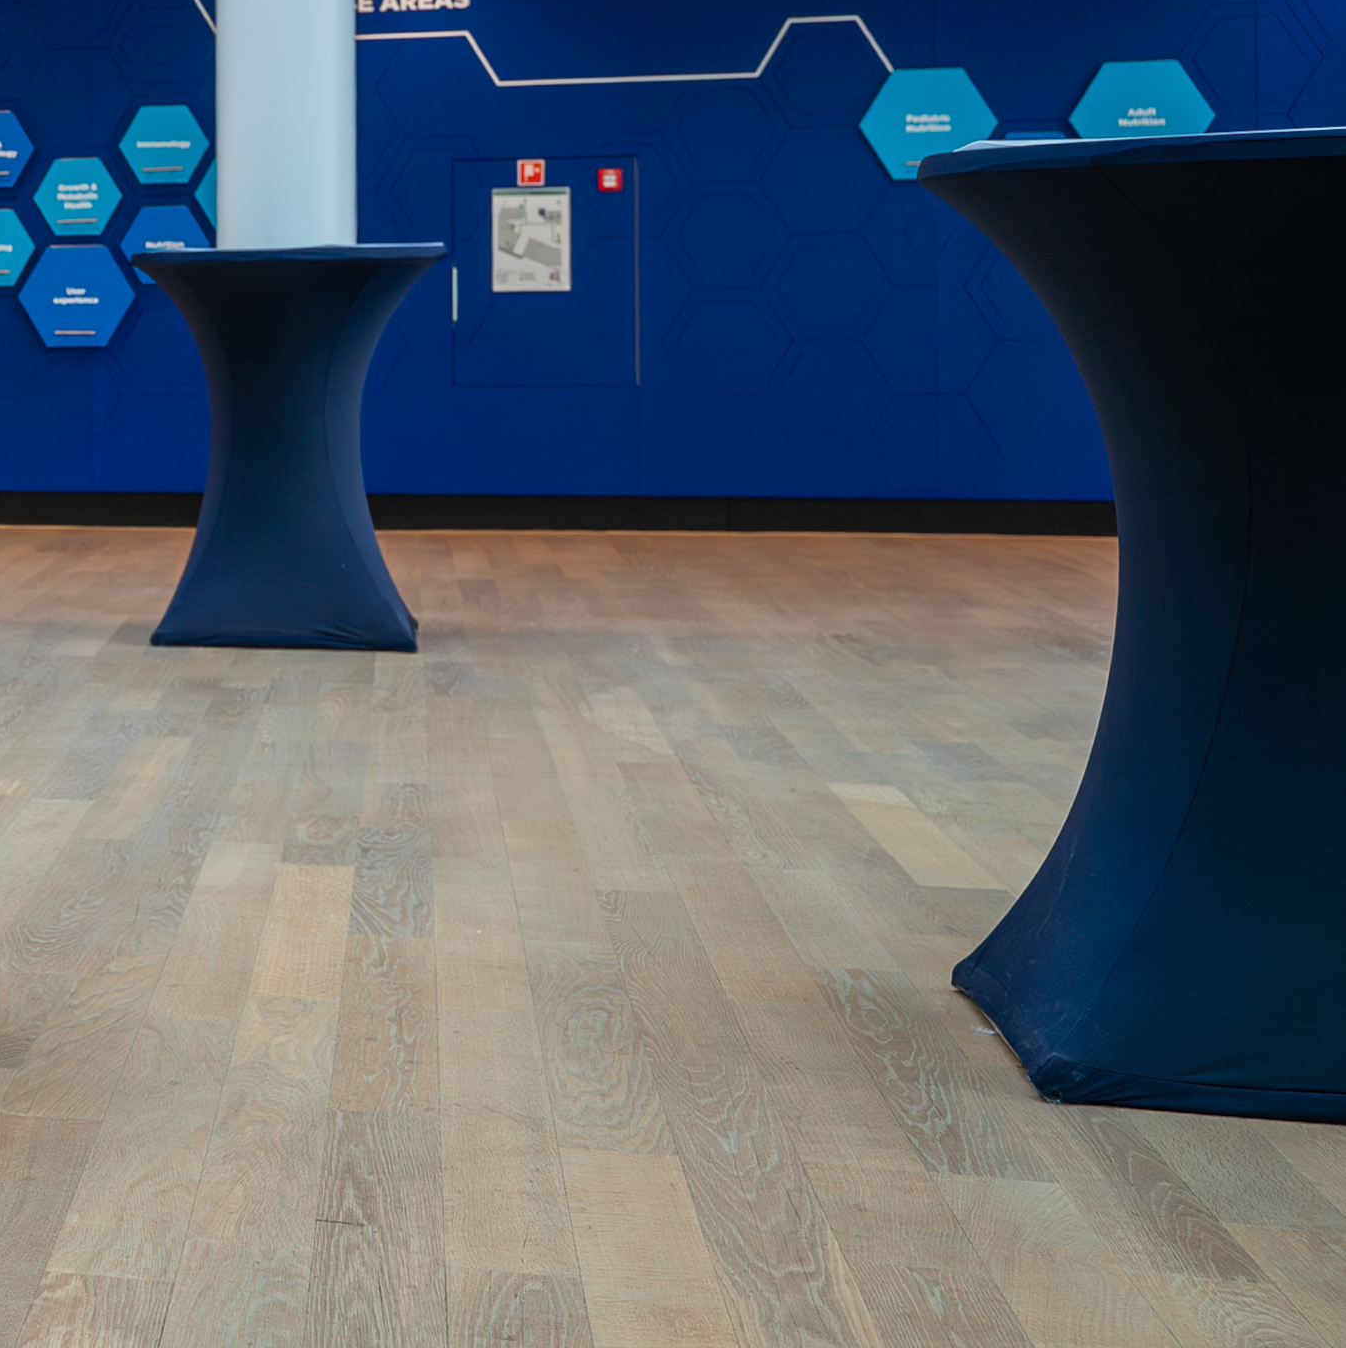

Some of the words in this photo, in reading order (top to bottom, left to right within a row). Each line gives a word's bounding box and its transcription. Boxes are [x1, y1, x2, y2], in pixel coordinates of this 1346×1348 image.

[1127, 107, 1157, 117] Adult
[905, 113, 951, 124] Pediatric
[1118, 116, 1166, 128] Nutrition
[905, 123, 952, 133] Nutrition
[136, 140, 191, 149] Immunology
[57, 182, 90, 192] Growth
[65, 286, 87, 296] User
[52, 296, 100, 306] experience
